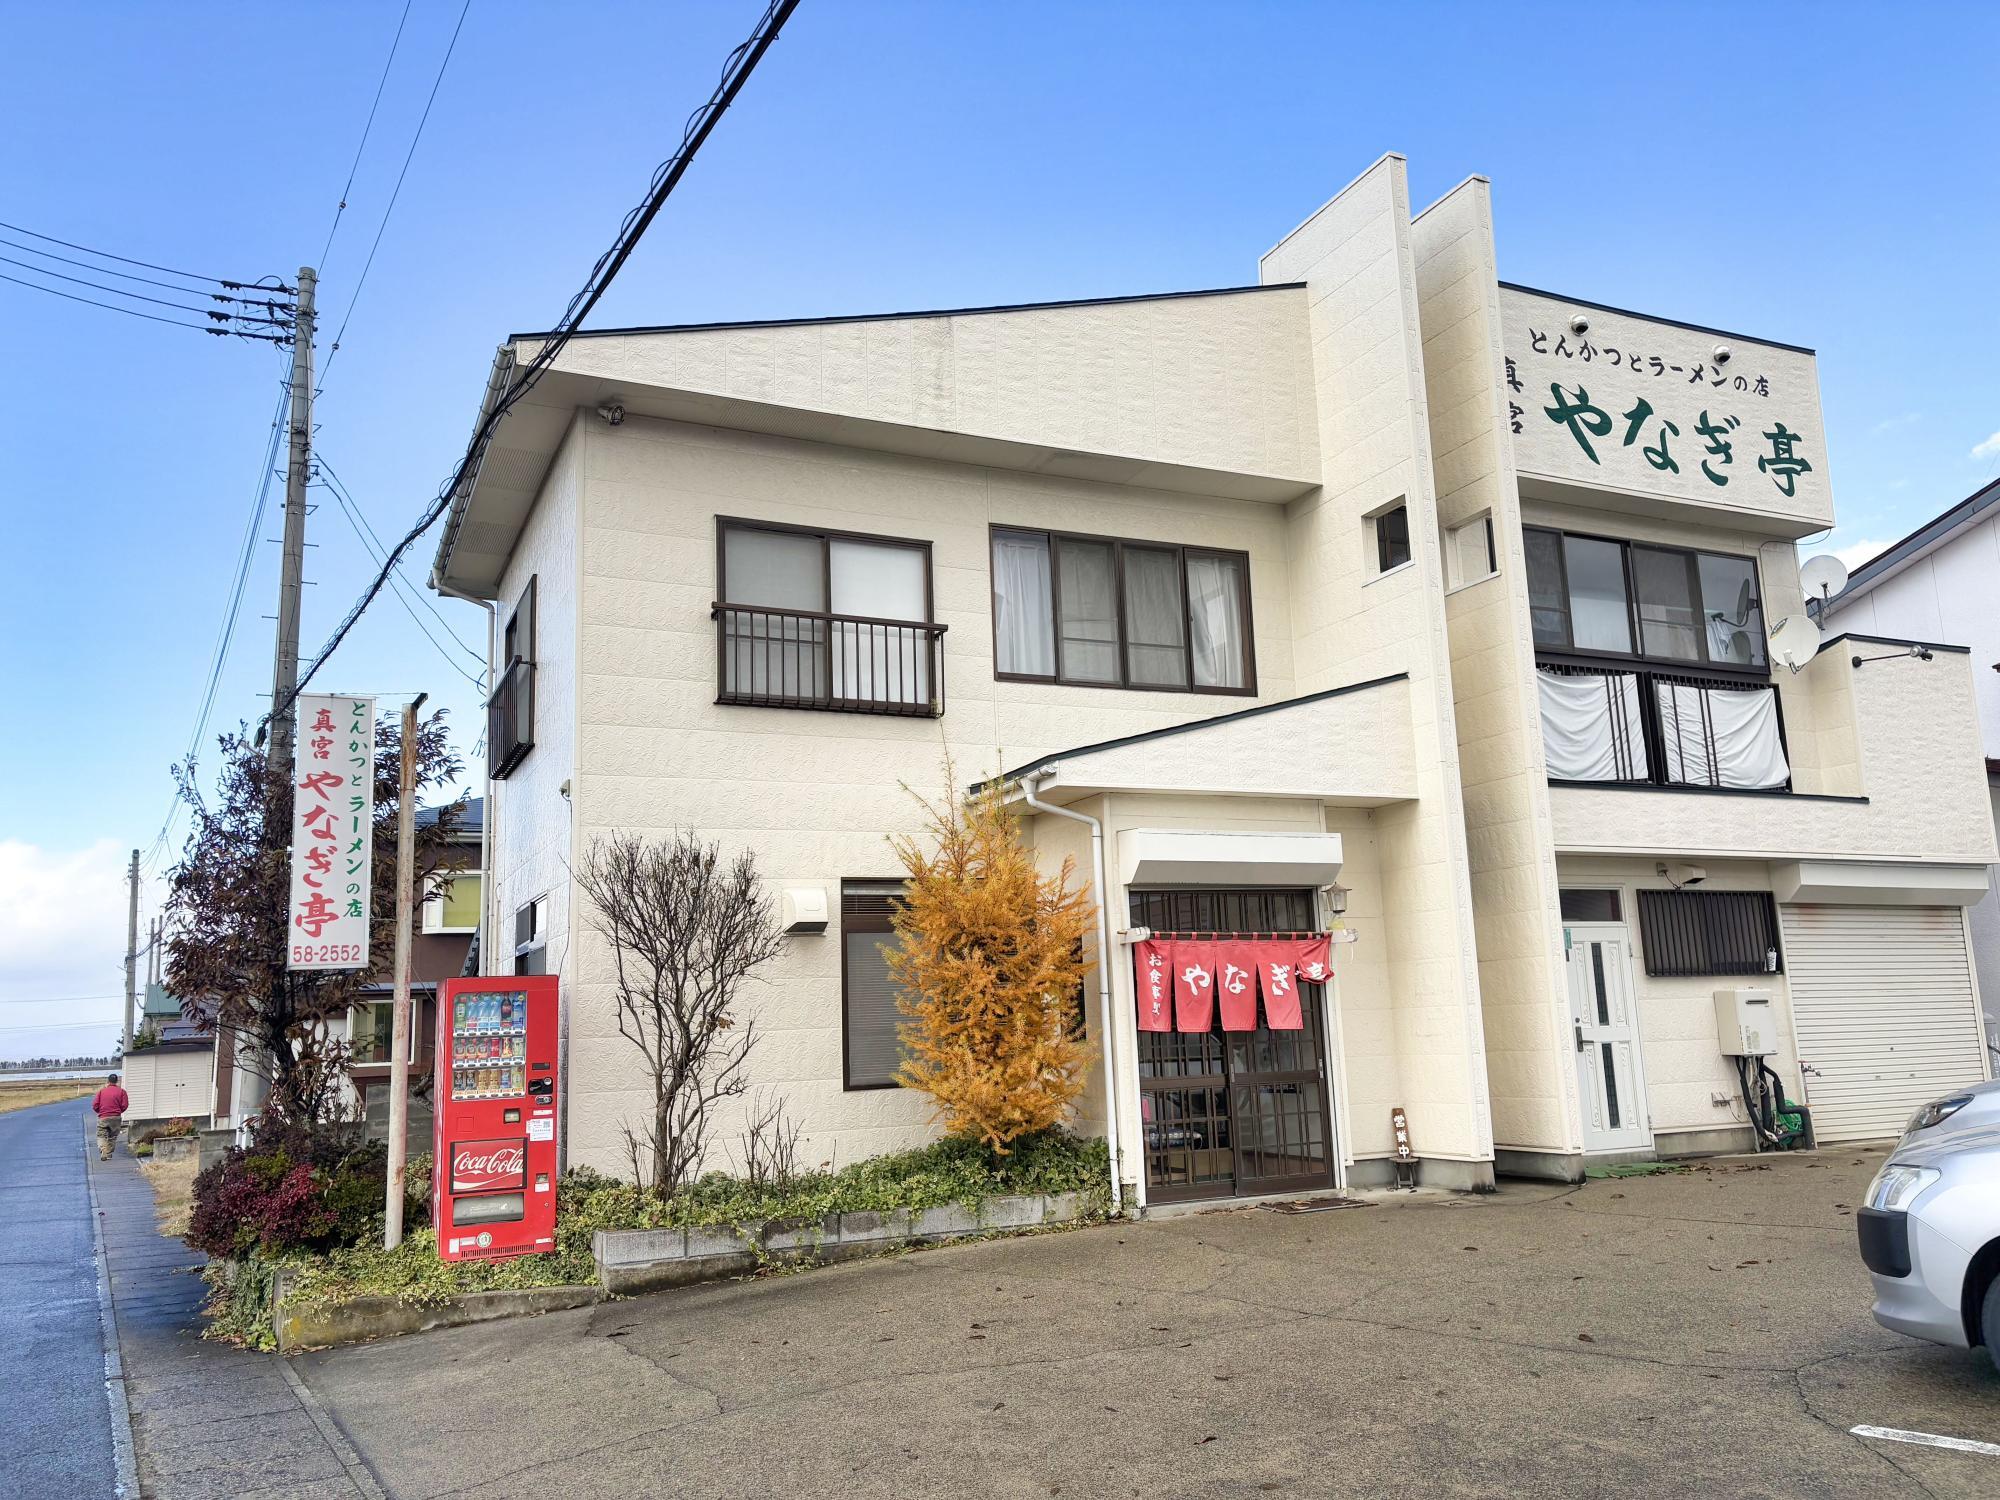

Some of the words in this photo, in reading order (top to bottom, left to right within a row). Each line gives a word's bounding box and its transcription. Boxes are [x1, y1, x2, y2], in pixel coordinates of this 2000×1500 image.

[1529, 328, 1770, 398] とんかつとラーメンの店
[1544, 382, 1812, 497] やなぎ亭
[343, 701, 368, 918] とんかつとラーメンの店
[292, 944, 361, 963] 58-2552
[454, 1147, 523, 1175] Coca-Cola
[1393, 1114, 1410, 1159] 営業中
